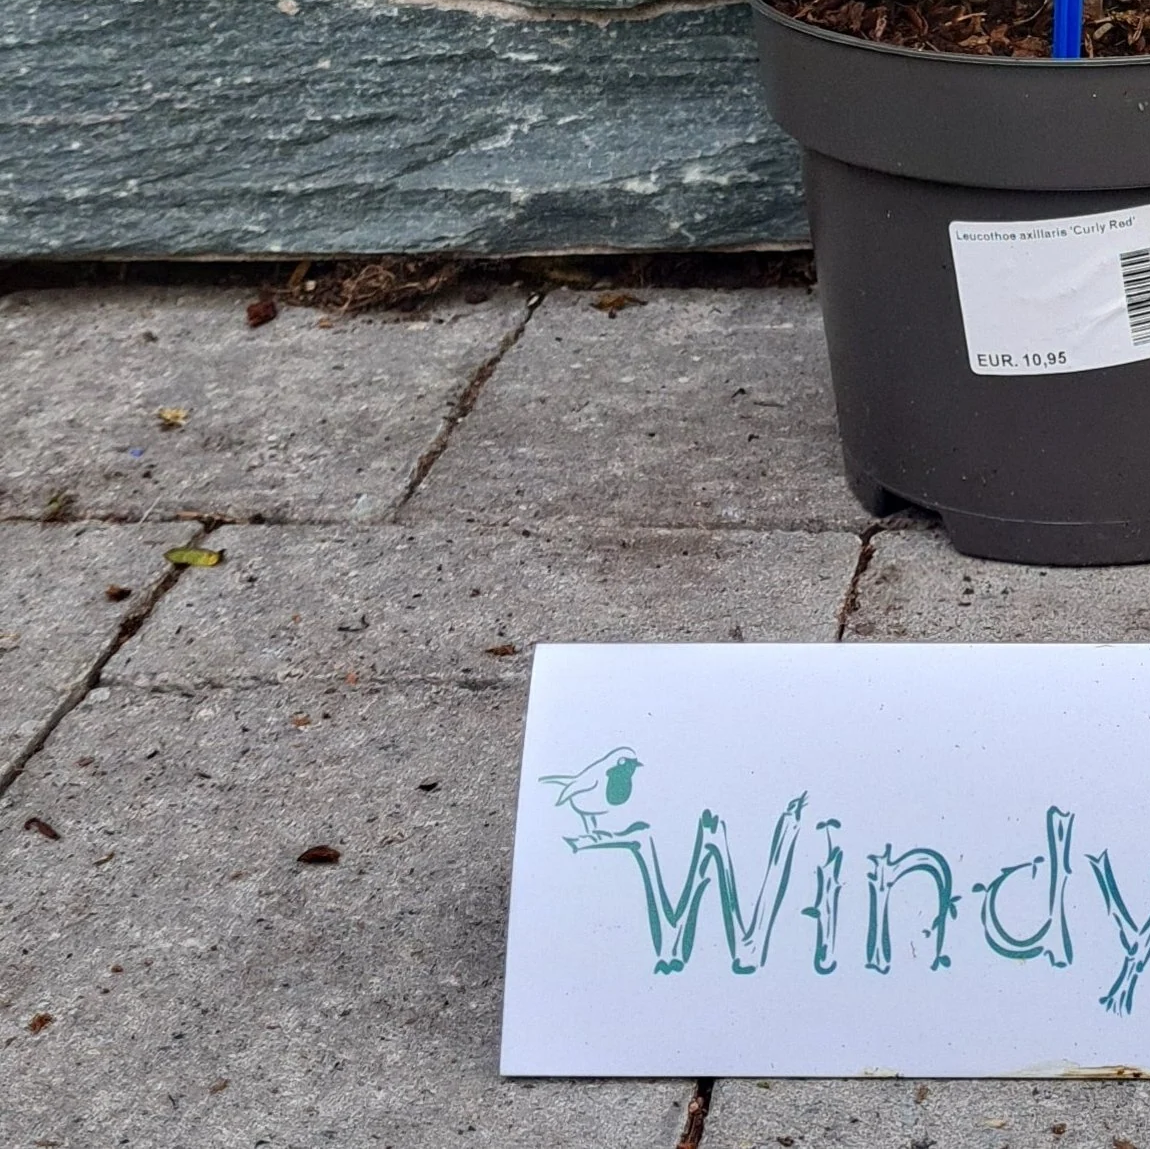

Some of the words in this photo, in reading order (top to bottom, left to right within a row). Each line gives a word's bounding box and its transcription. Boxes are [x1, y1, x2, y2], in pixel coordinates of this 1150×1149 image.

[956, 229, 1017, 242] Leucothoe
[1020, 227, 1068, 241] axillaris
[1070, 222, 1106, 237] 'Curly
[1109, 216, 1136, 230] Red'
[976, 353, 1018, 368] EUR.
[1022, 351, 1067, 370] 10,95
